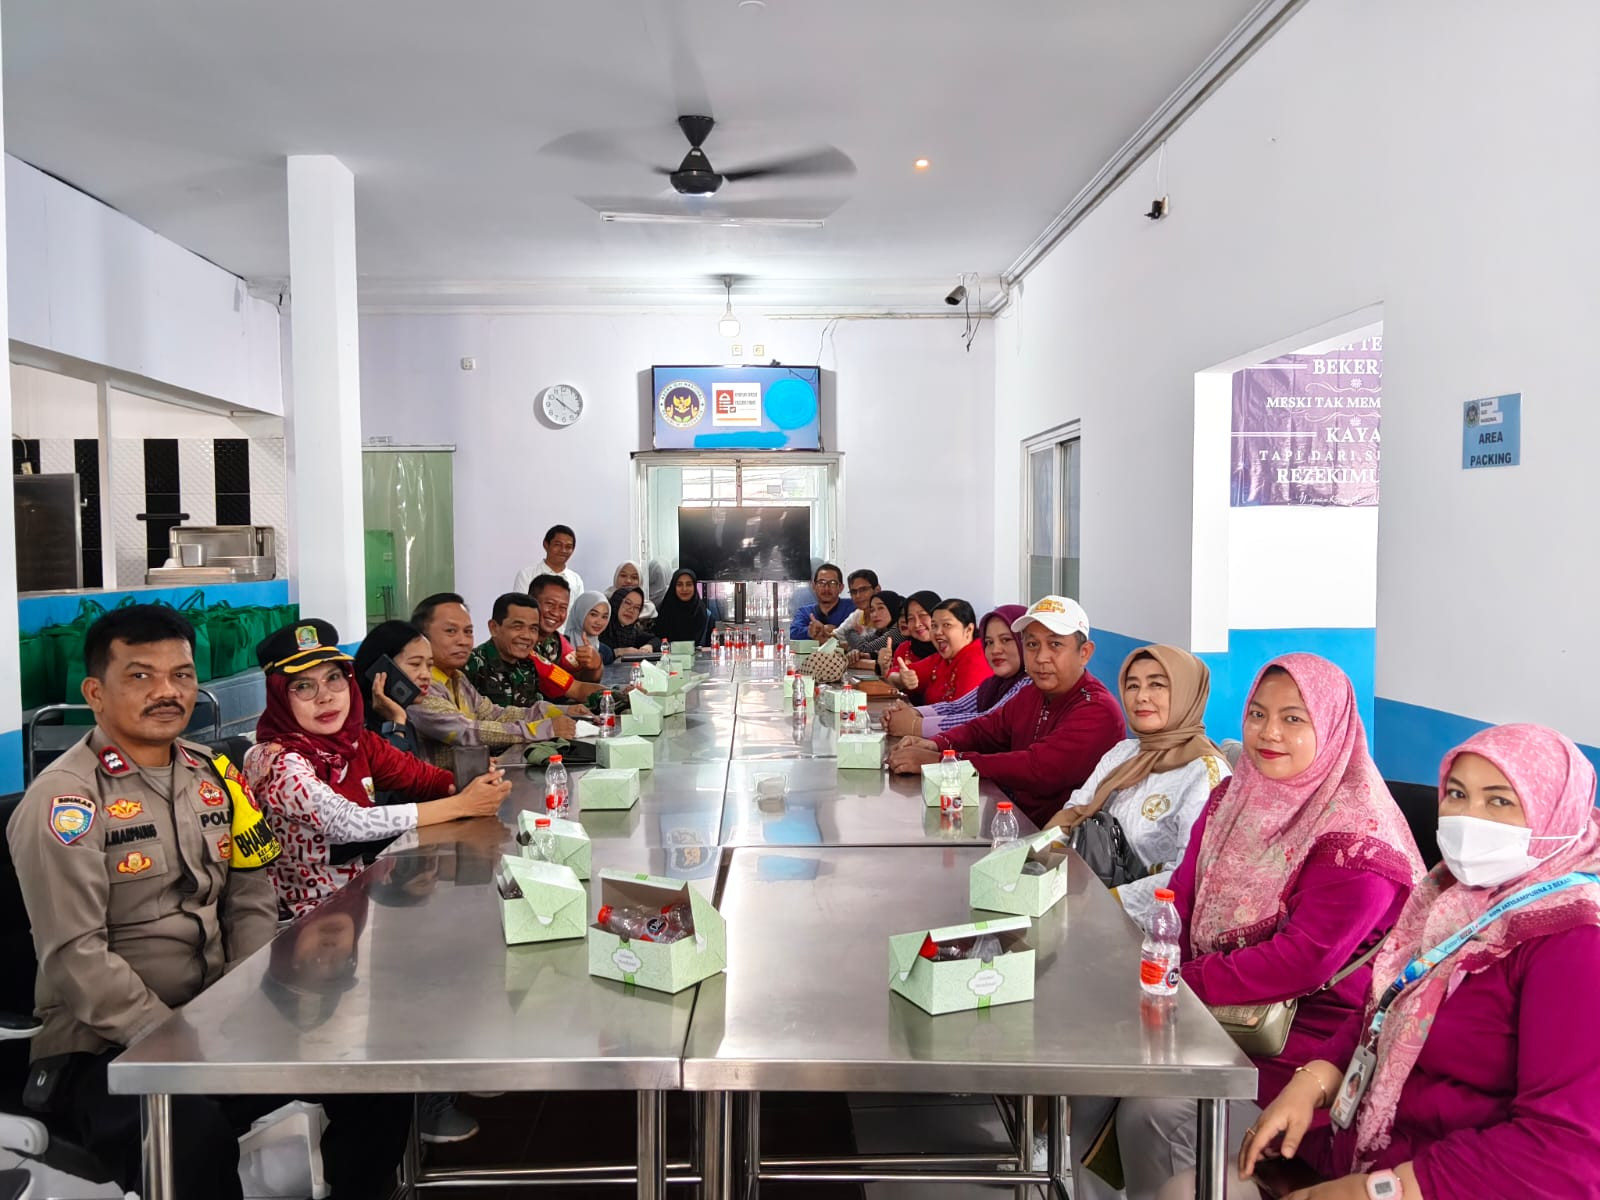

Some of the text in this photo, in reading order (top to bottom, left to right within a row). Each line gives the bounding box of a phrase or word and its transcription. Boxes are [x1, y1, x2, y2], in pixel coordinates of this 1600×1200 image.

[1266, 396, 1312, 409] MESKI
[1315, 396, 1344, 409] TAK
[1326, 427, 1381, 443] KAYA
[1479, 431, 1504, 444] AREA
[1259, 450, 1302, 461] TAPI
[1311, 450, 1356, 461] DARI
[1470, 452, 1512, 467] PACKING
